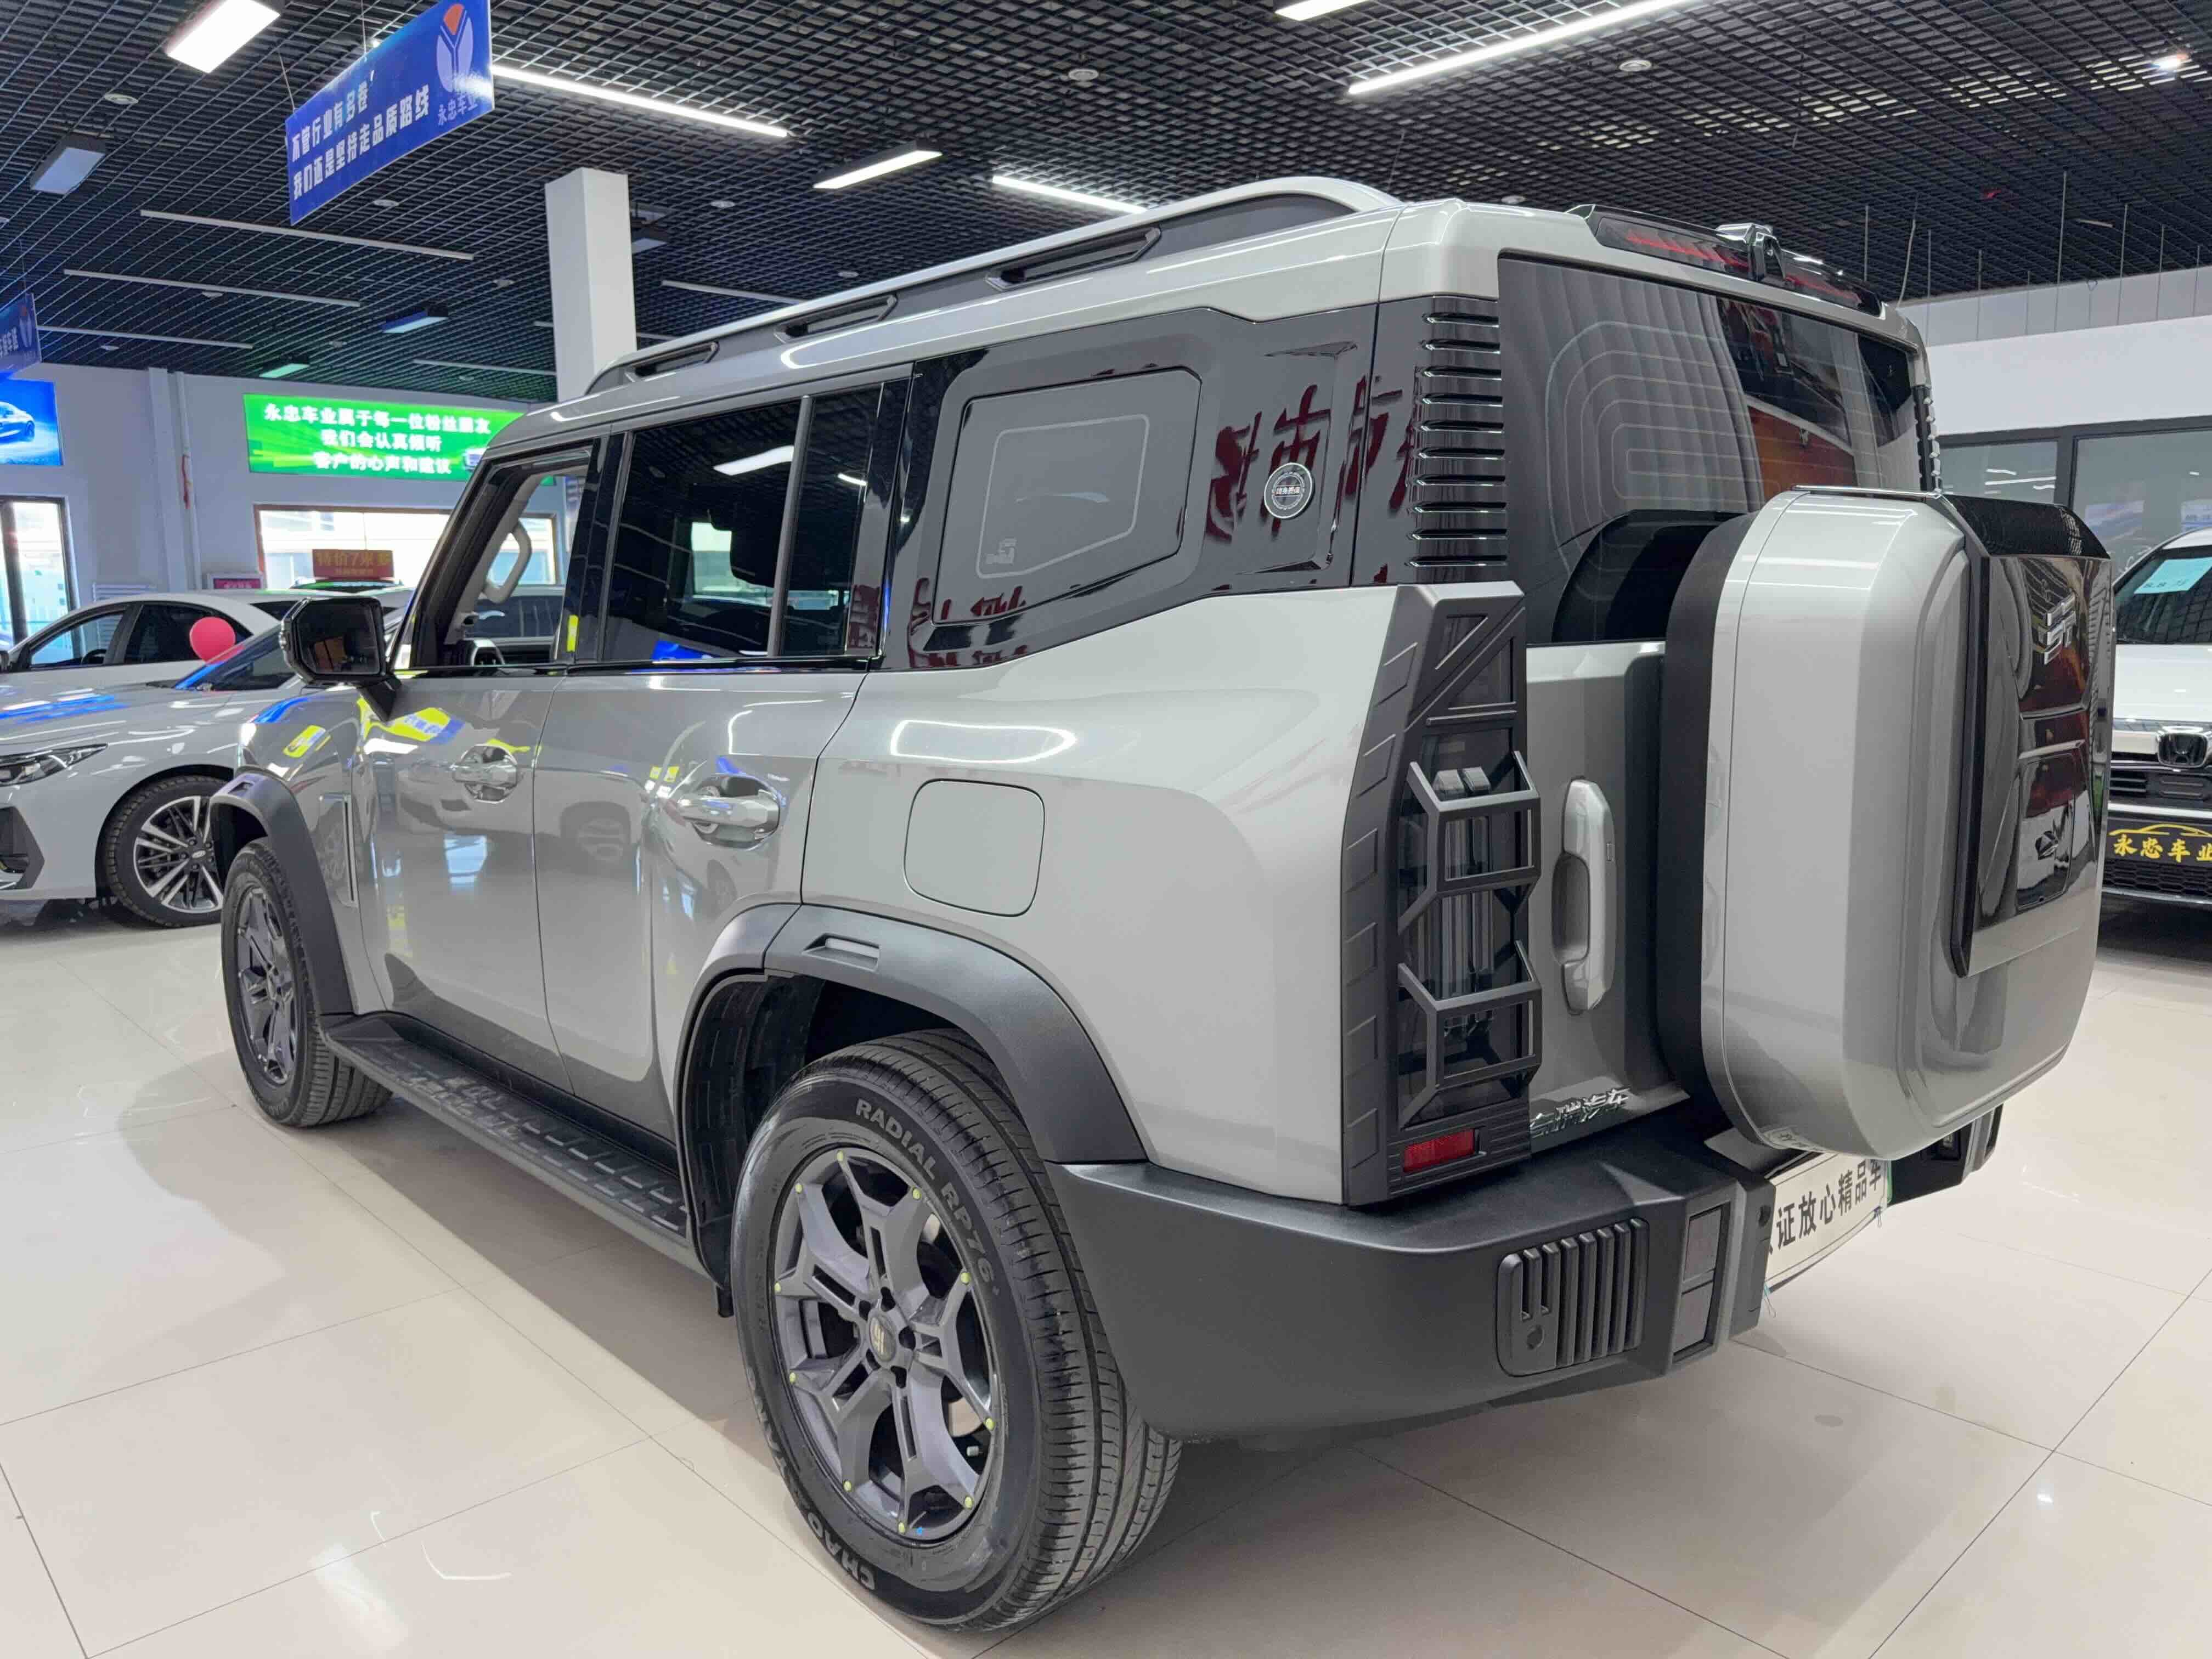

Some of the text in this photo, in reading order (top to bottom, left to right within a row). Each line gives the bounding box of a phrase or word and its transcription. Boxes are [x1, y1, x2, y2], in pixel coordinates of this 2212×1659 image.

[855, 1098, 936, 1180] RADIAL
[1769, 1158, 1881, 1255] 证放心精品车
